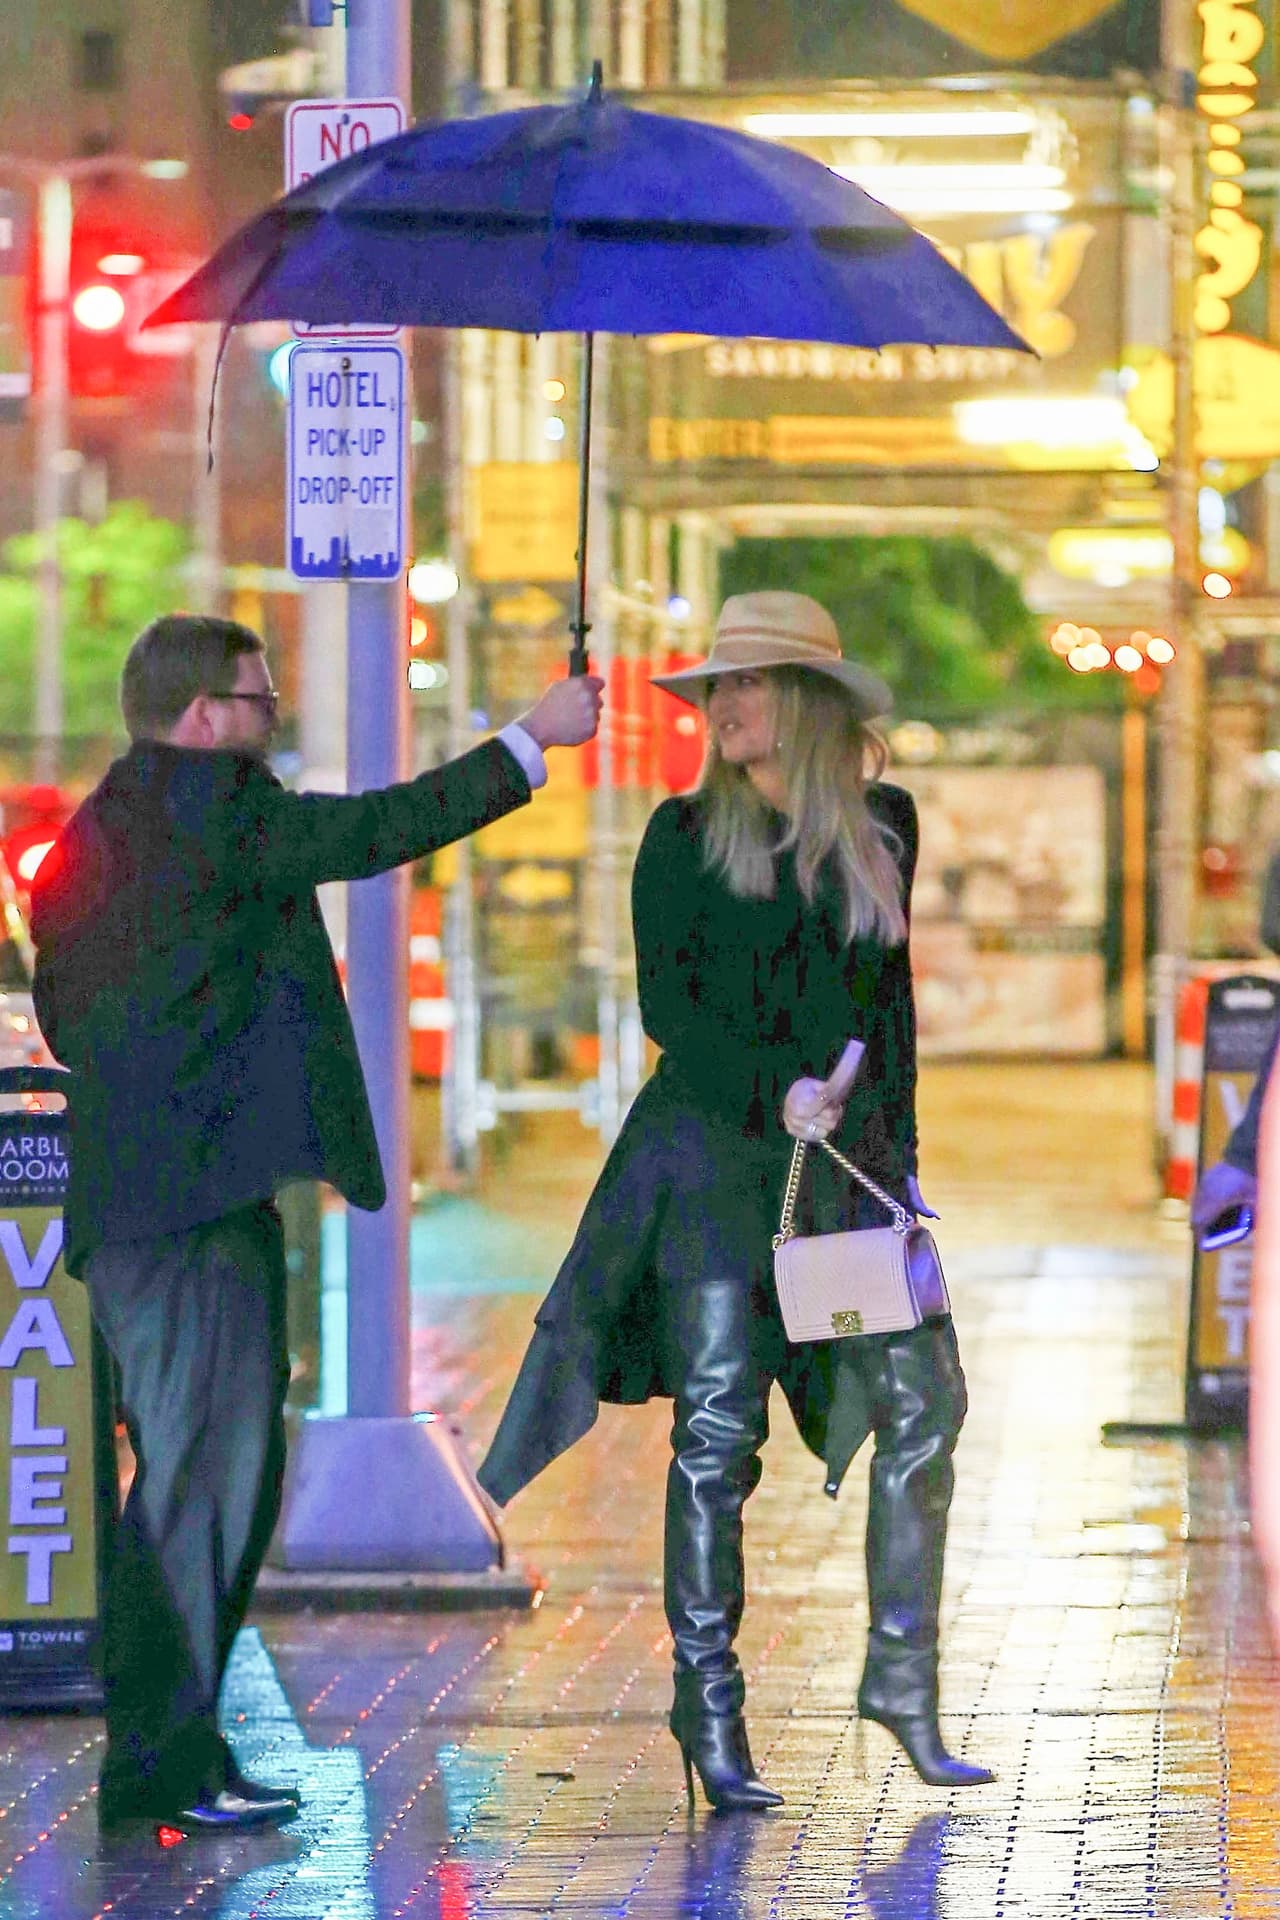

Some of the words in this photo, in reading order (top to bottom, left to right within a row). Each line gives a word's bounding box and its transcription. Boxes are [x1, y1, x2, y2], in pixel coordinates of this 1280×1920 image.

[320, 121, 371, 161] NO
[307, 371, 387, 408] HOTEL
[307, 428, 386, 456] PICK-UP
[298, 476, 395, 504] DROP-OFF
[0, 1136, 66, 1158] ARBL
[0, 1160, 69, 1181] OOM
[0, 1218, 76, 1605] VALET
[18, 1631, 86, 1644] TOWNE
